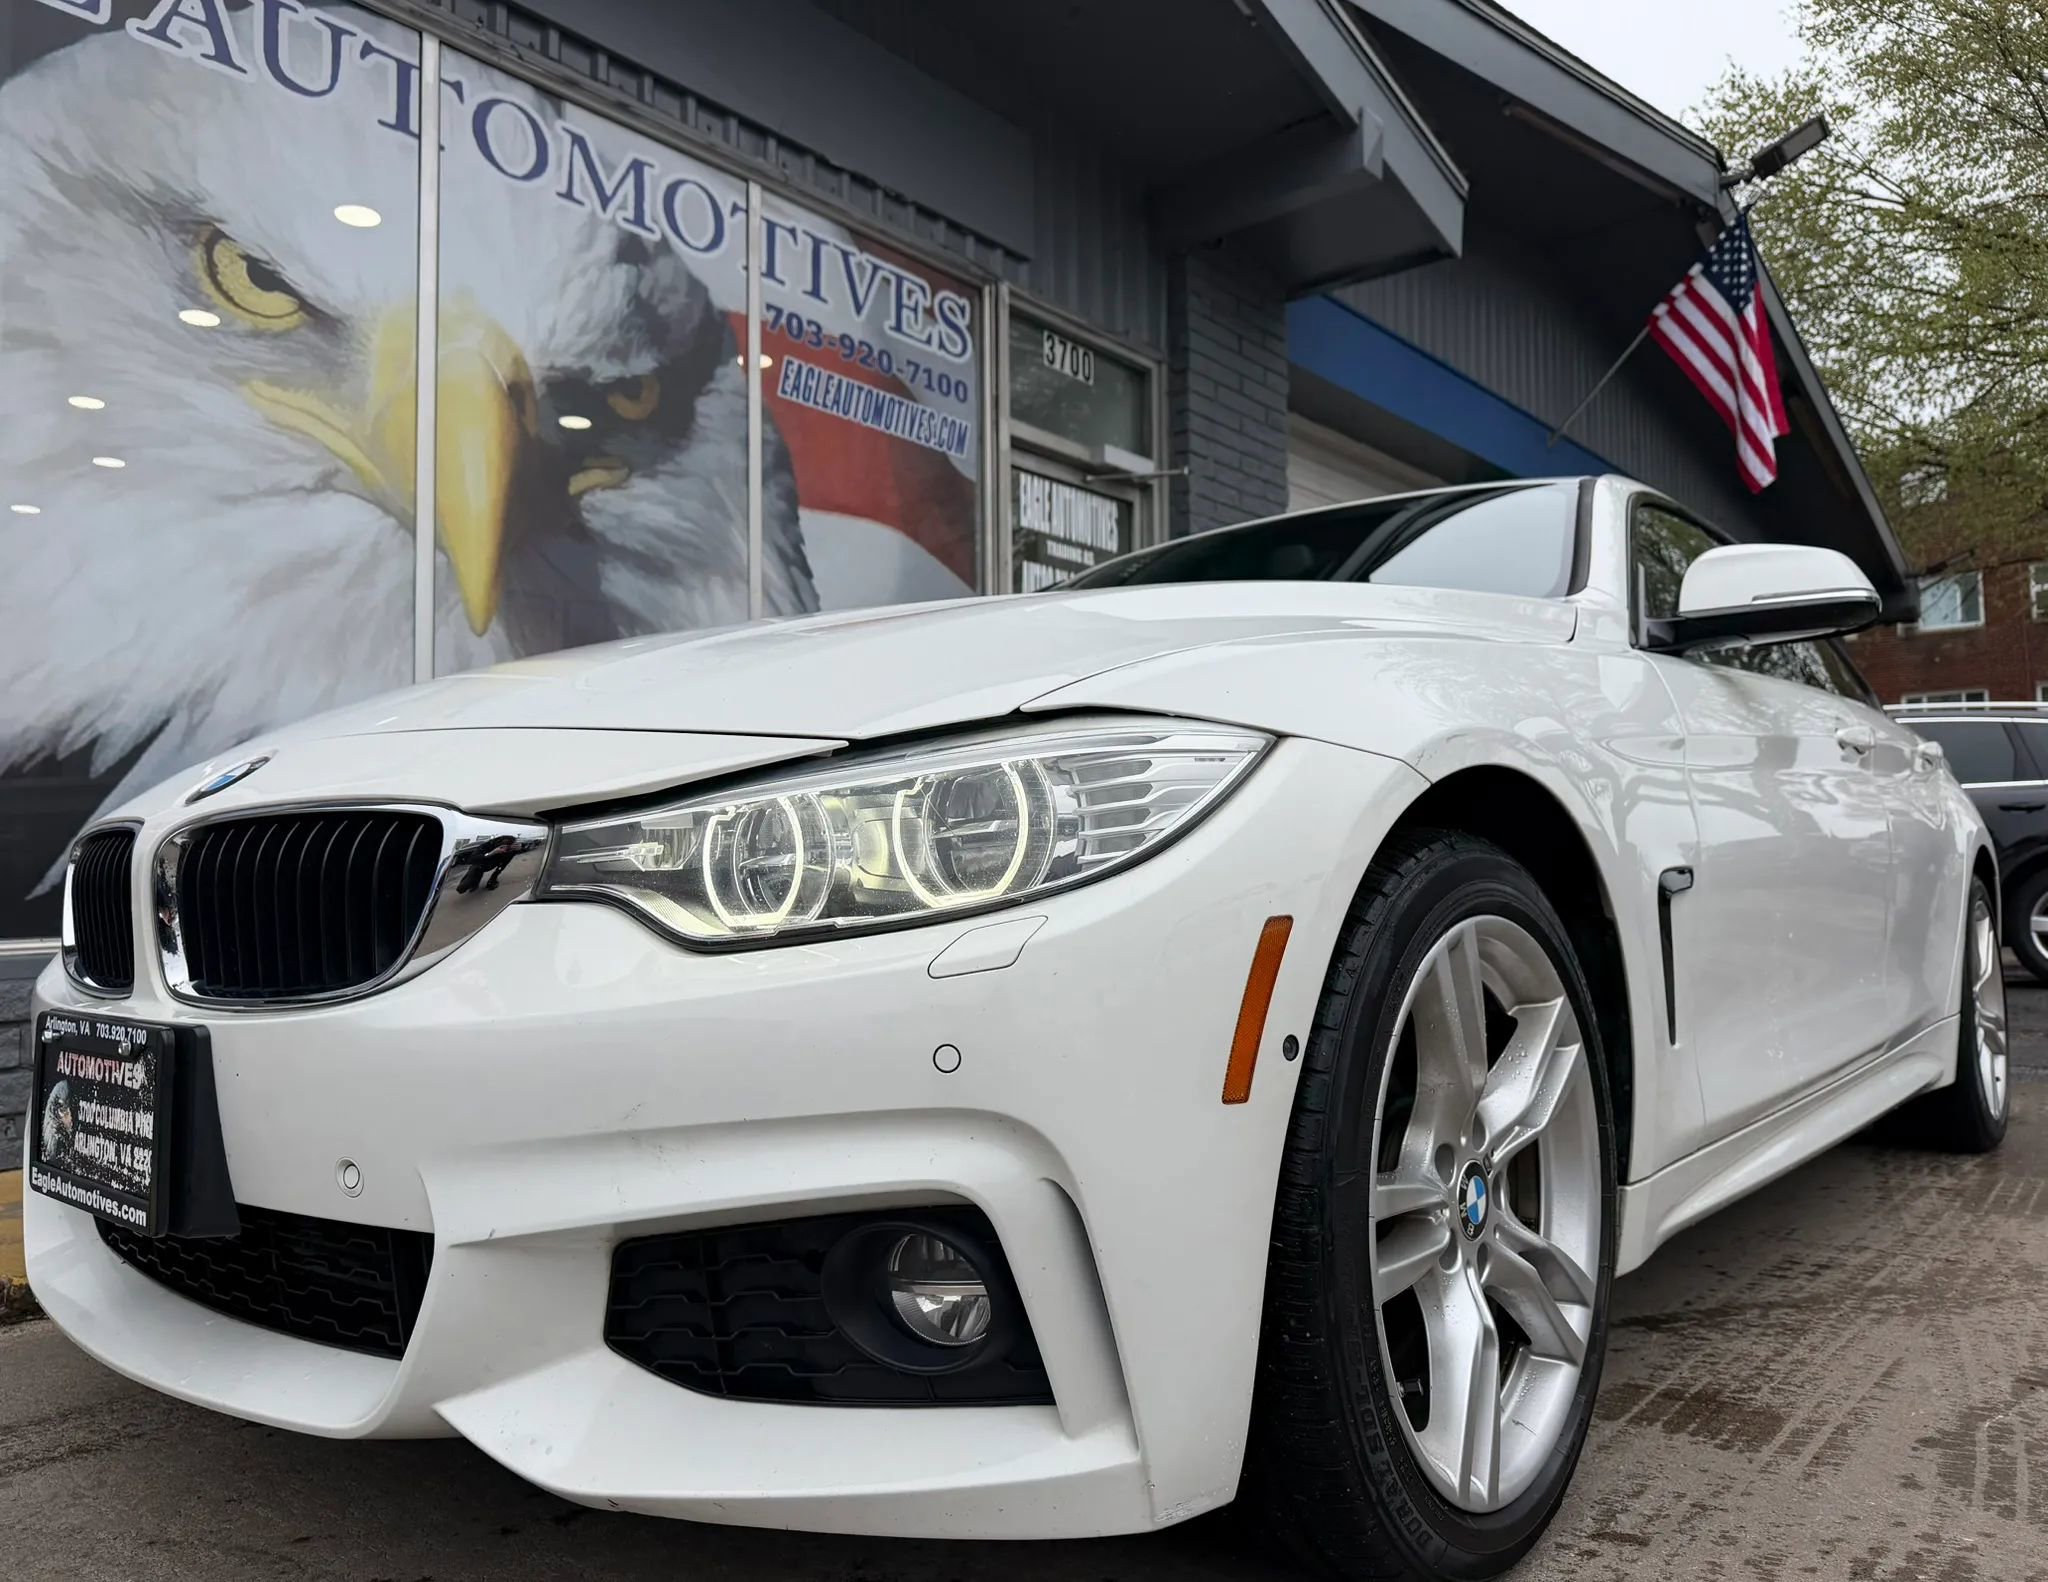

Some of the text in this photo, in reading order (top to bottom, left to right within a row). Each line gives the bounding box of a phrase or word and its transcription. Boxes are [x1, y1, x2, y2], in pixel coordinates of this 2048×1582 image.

[136, 0, 970, 360] AUTOMOTIVES
[764, 304, 969, 404] 703-920-7100
[1044, 334, 1092, 382] 3700
[779, 358, 968, 455] EAGLEAUTOMOTIVES.COM
[45, 1015, 147, 1045] Arlington, VA 703.920.7100
[57, 1051, 142, 1090] AUTOMOTIVES
[31, 1167, 147, 1228] EagleAutomotives.com
